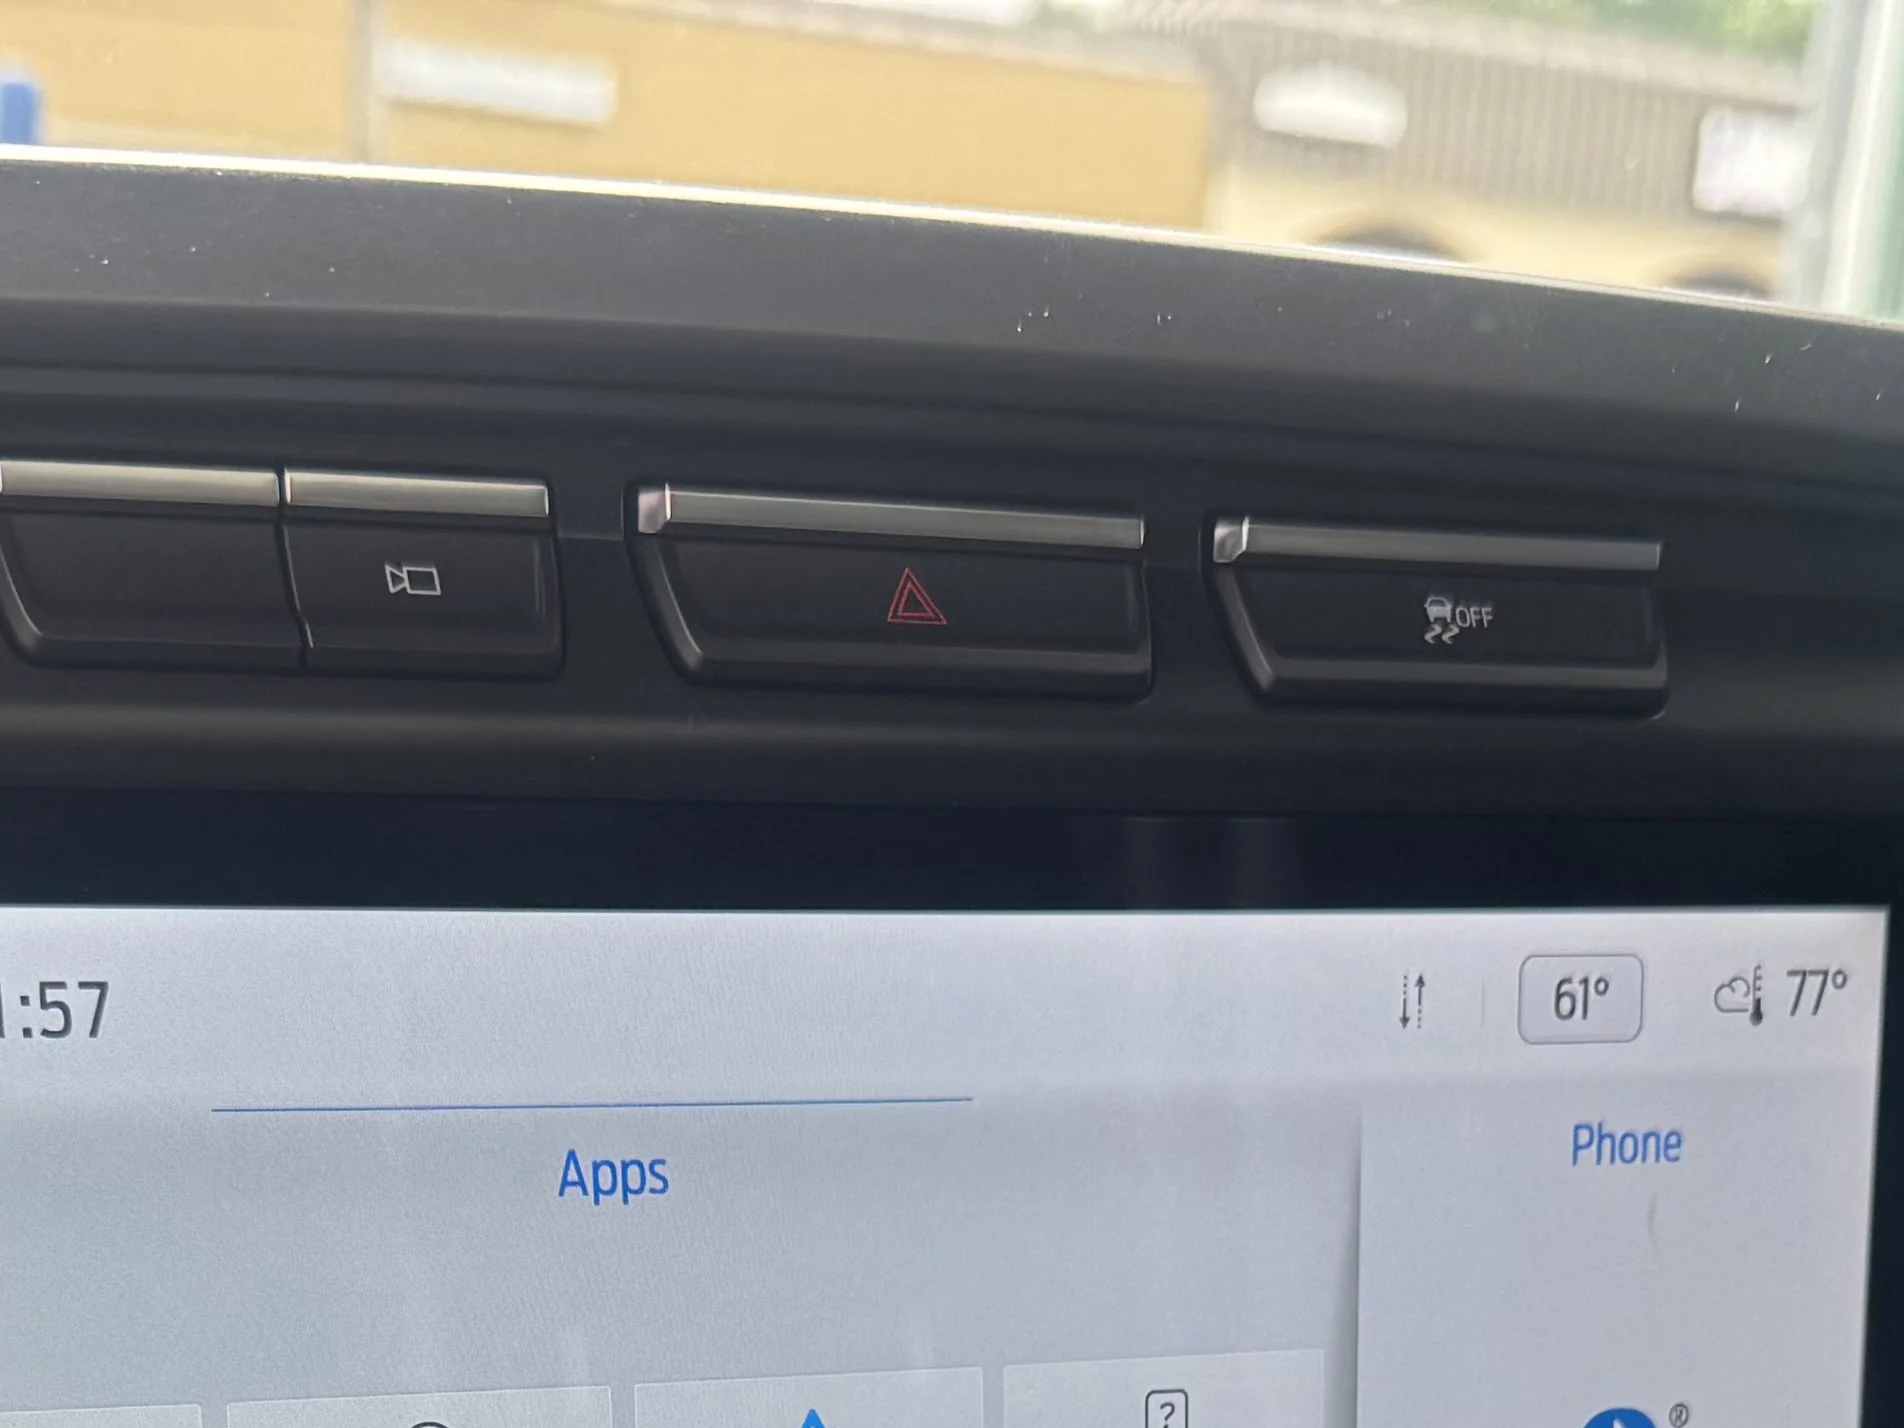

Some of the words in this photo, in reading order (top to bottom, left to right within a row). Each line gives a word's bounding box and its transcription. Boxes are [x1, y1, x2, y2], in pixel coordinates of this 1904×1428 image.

[1454, 606, 1494, 628] OFF
[1554, 976, 1610, 1021] 61°
[1786, 968, 1848, 1017] 77°
[1572, 1121, 1683, 1167] Phone
[558, 1148, 669, 1206] Apps
